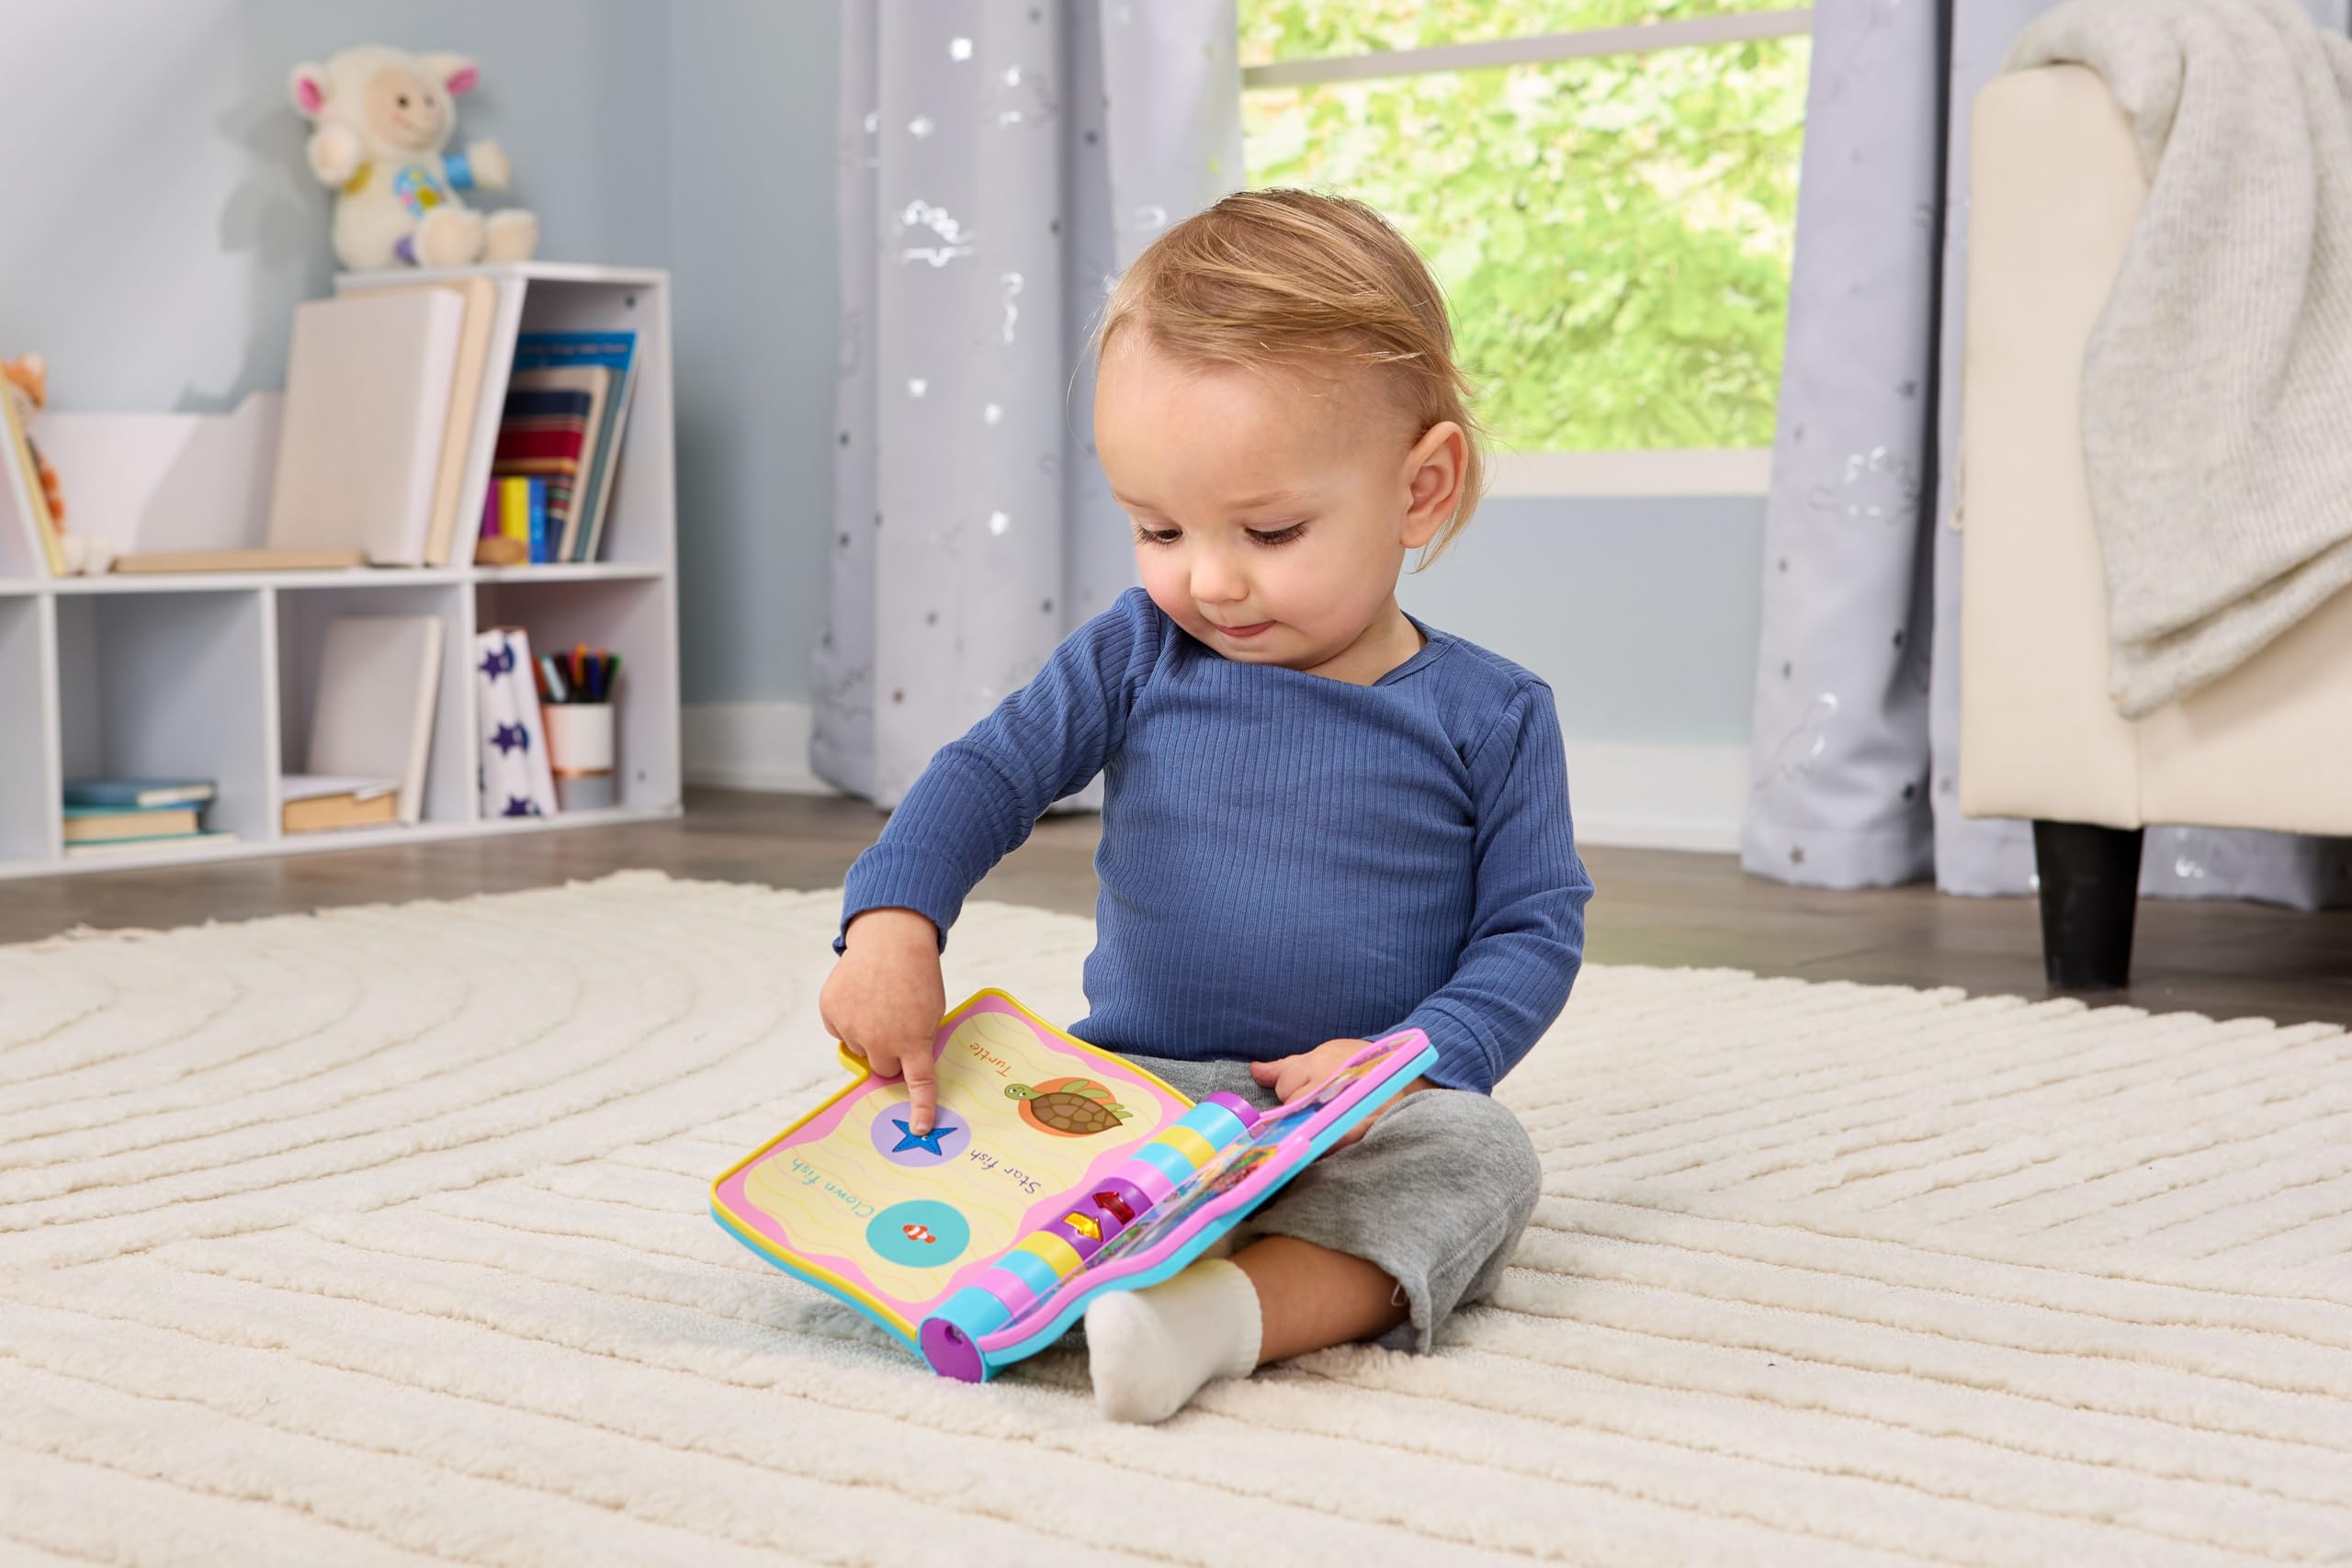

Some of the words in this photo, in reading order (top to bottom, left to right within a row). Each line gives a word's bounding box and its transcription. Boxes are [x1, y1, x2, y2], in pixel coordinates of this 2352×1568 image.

[969, 1043, 1012, 1077] Turtle
[792, 1157, 821, 1185] fish
[970, 1149, 1000, 1170] fish
[1003, 1168, 1042, 1194] Star
[823, 1182, 875, 1217] Clown
